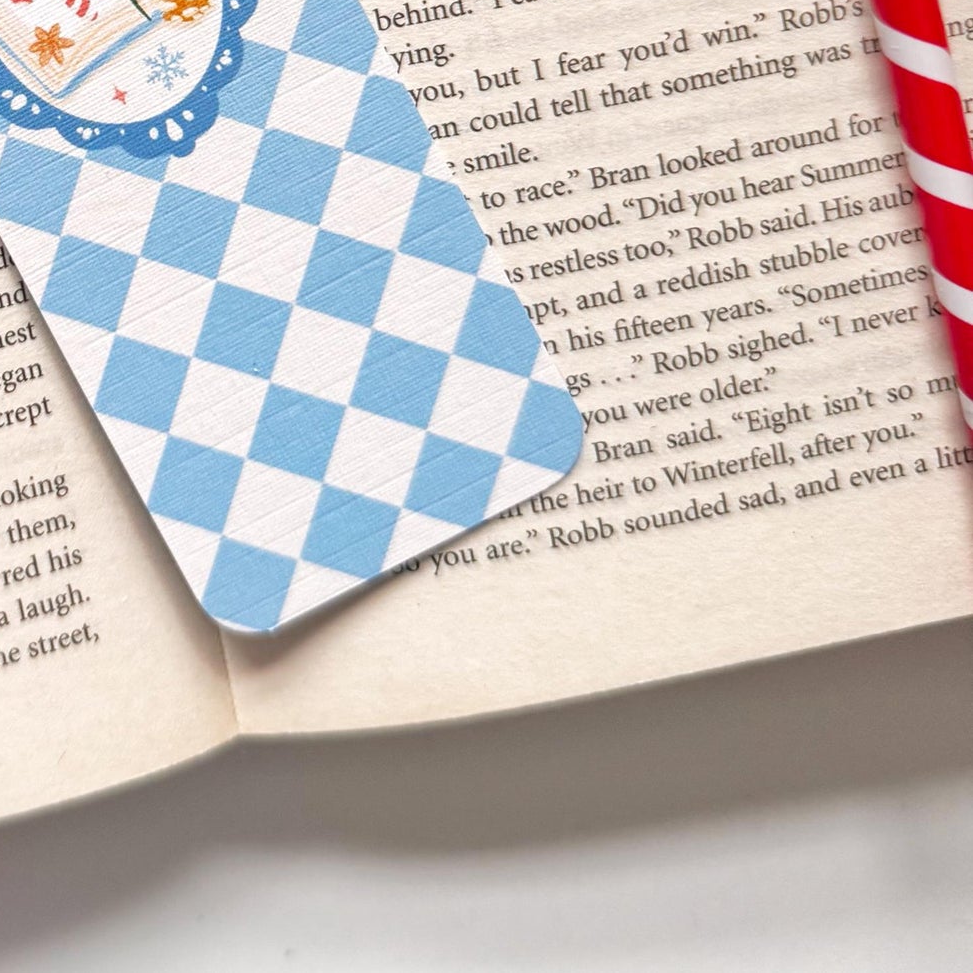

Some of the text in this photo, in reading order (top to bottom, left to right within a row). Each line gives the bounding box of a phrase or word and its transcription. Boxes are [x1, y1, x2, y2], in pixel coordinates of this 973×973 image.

[473, 66, 522, 92] but
[530, 57, 546, 82] I
[556, 51, 607, 77] fear
[463, 141, 539, 174] smile.
[497, 220, 539, 246] the
[542, 202, 622, 238] wood.
[687, 186, 738, 217] you
[739, 174, 796, 200] hear
[581, 404, 629, 434] you
[632, 391, 692, 417] were
[661, 441, 796, 488] Winterfell,
[800, 432, 857, 460] after
[547, 458, 930, 550] Robb sounded sad, and even a
[16, 583, 91, 623] laugh.
